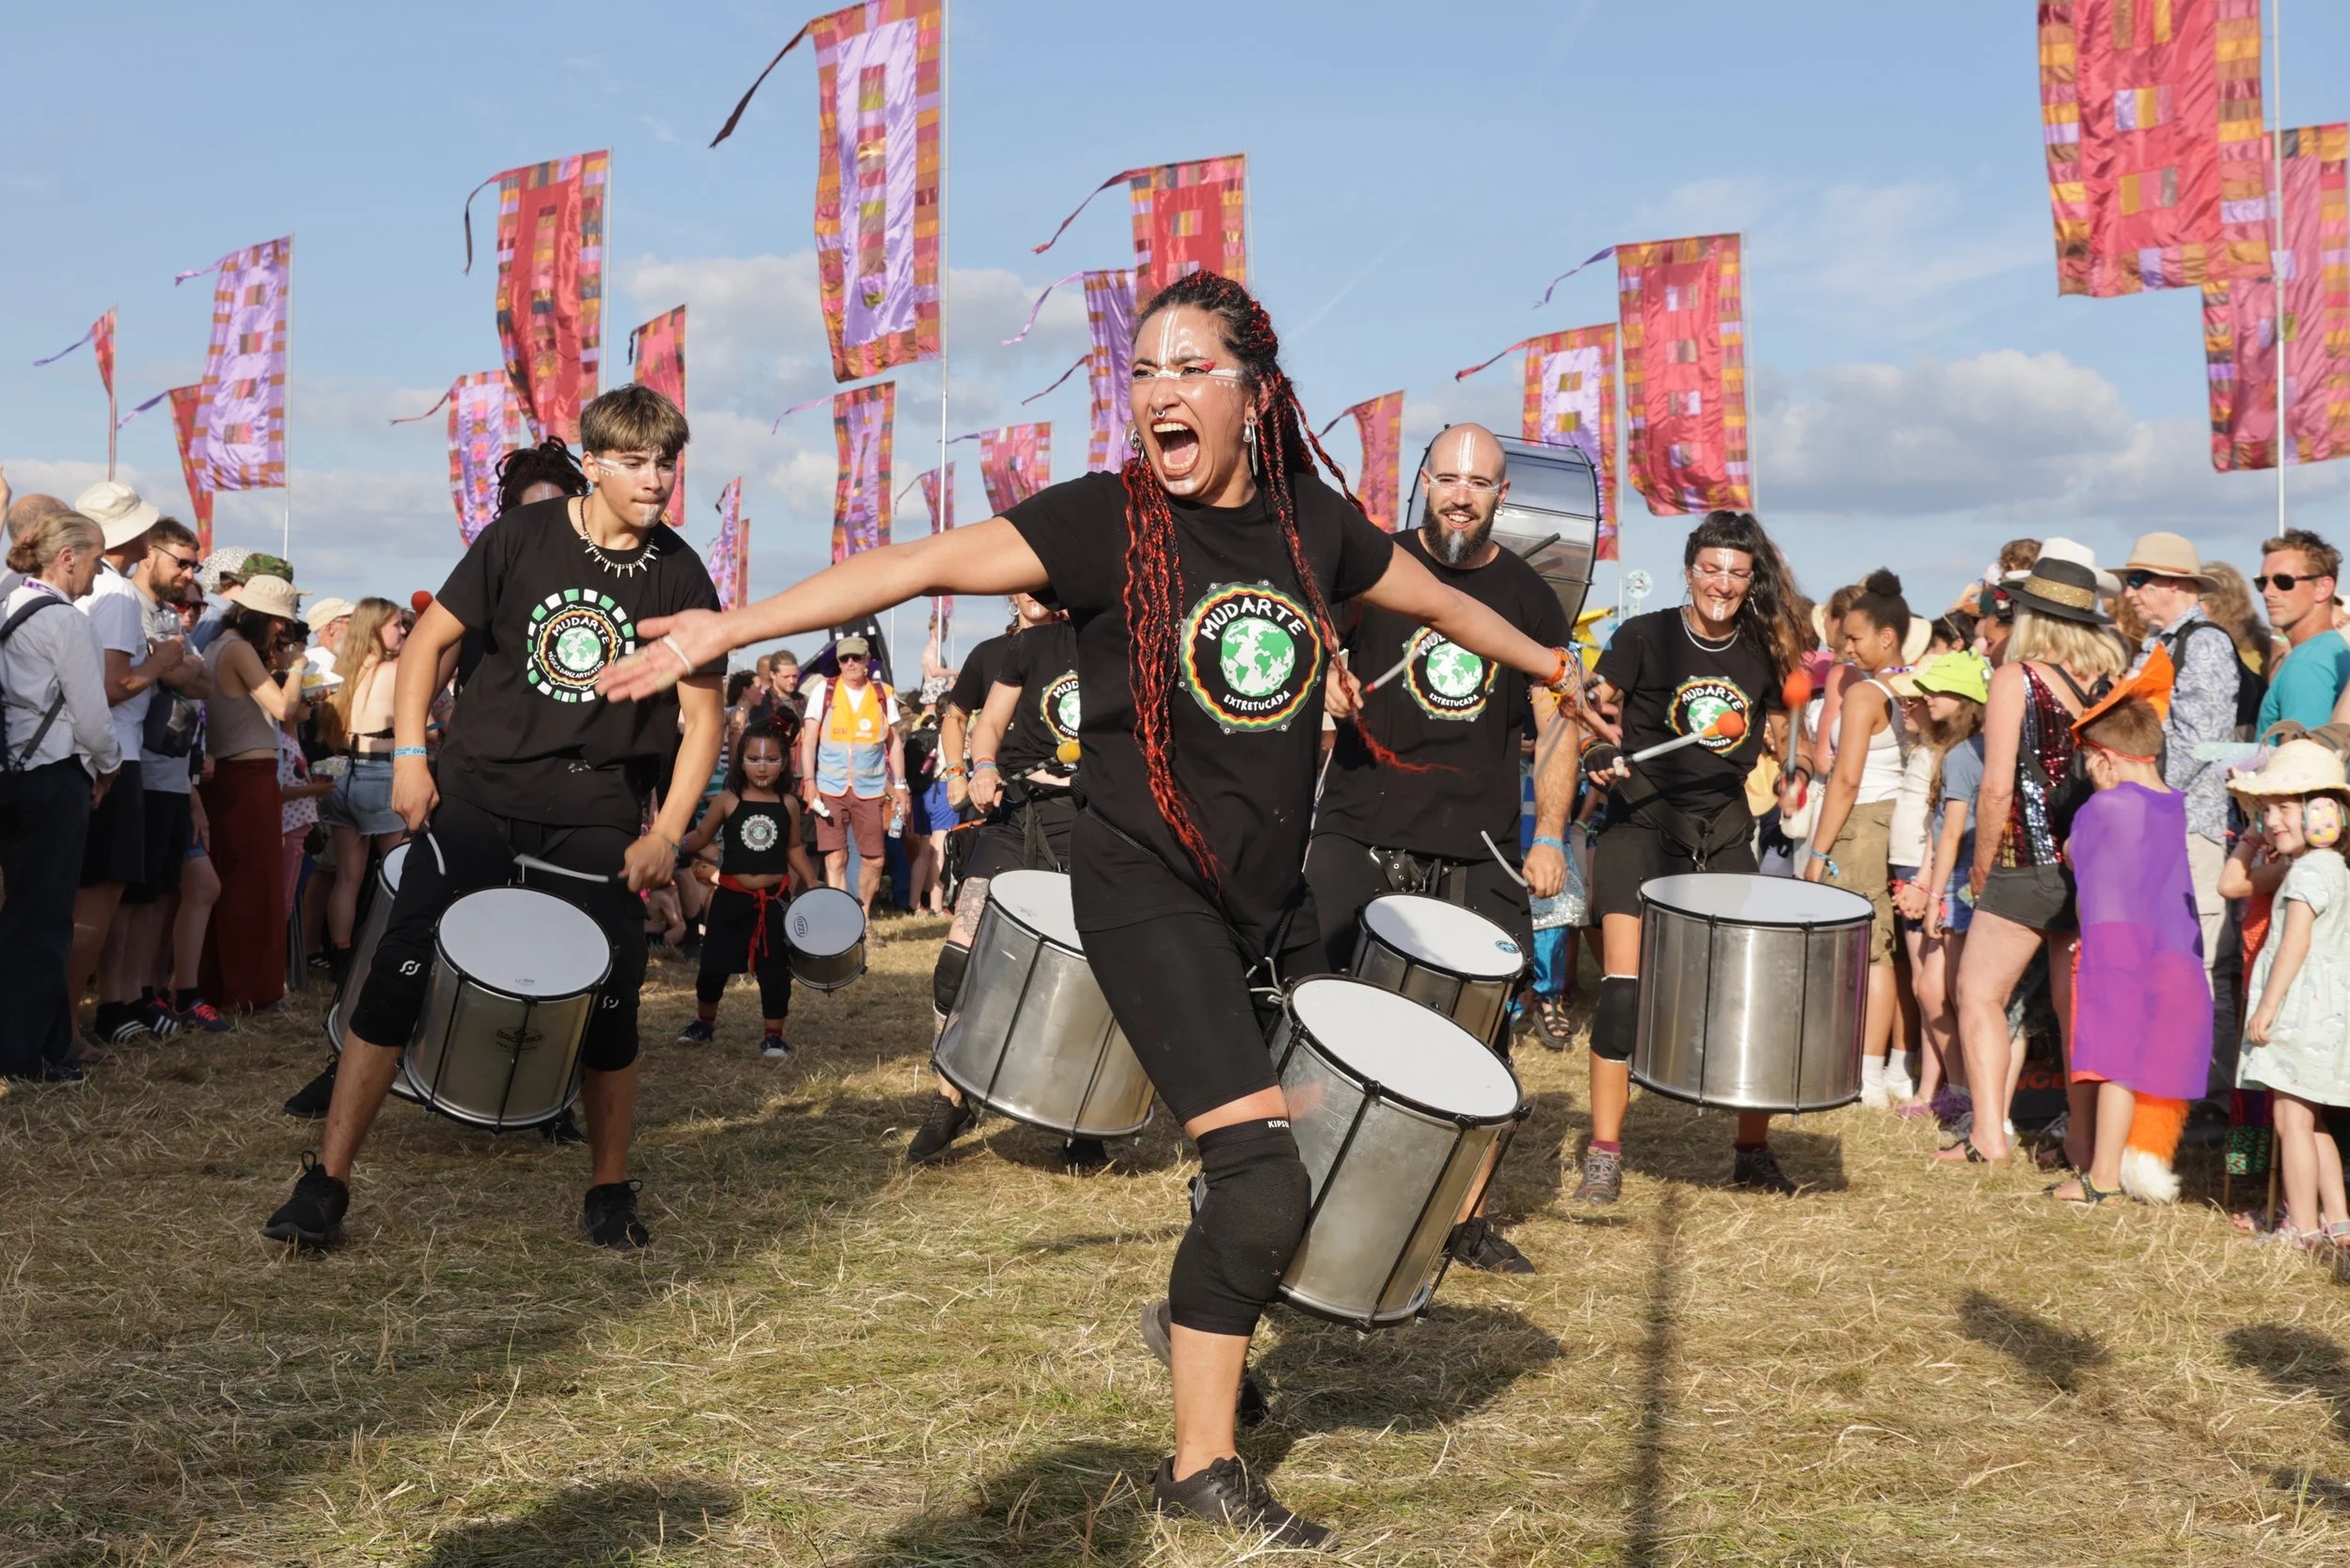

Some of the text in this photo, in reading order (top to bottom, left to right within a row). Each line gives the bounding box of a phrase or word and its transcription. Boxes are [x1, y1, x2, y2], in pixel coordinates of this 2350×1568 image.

[552, 617, 610, 644] MUDARTE
[1200, 597, 1307, 641] MUDARTE
[1223, 690, 1292, 712] EXTRETUCADA
[1429, 693, 1480, 707] EXTRETUCADA
[1682, 685, 1745, 711] MUDARTE
